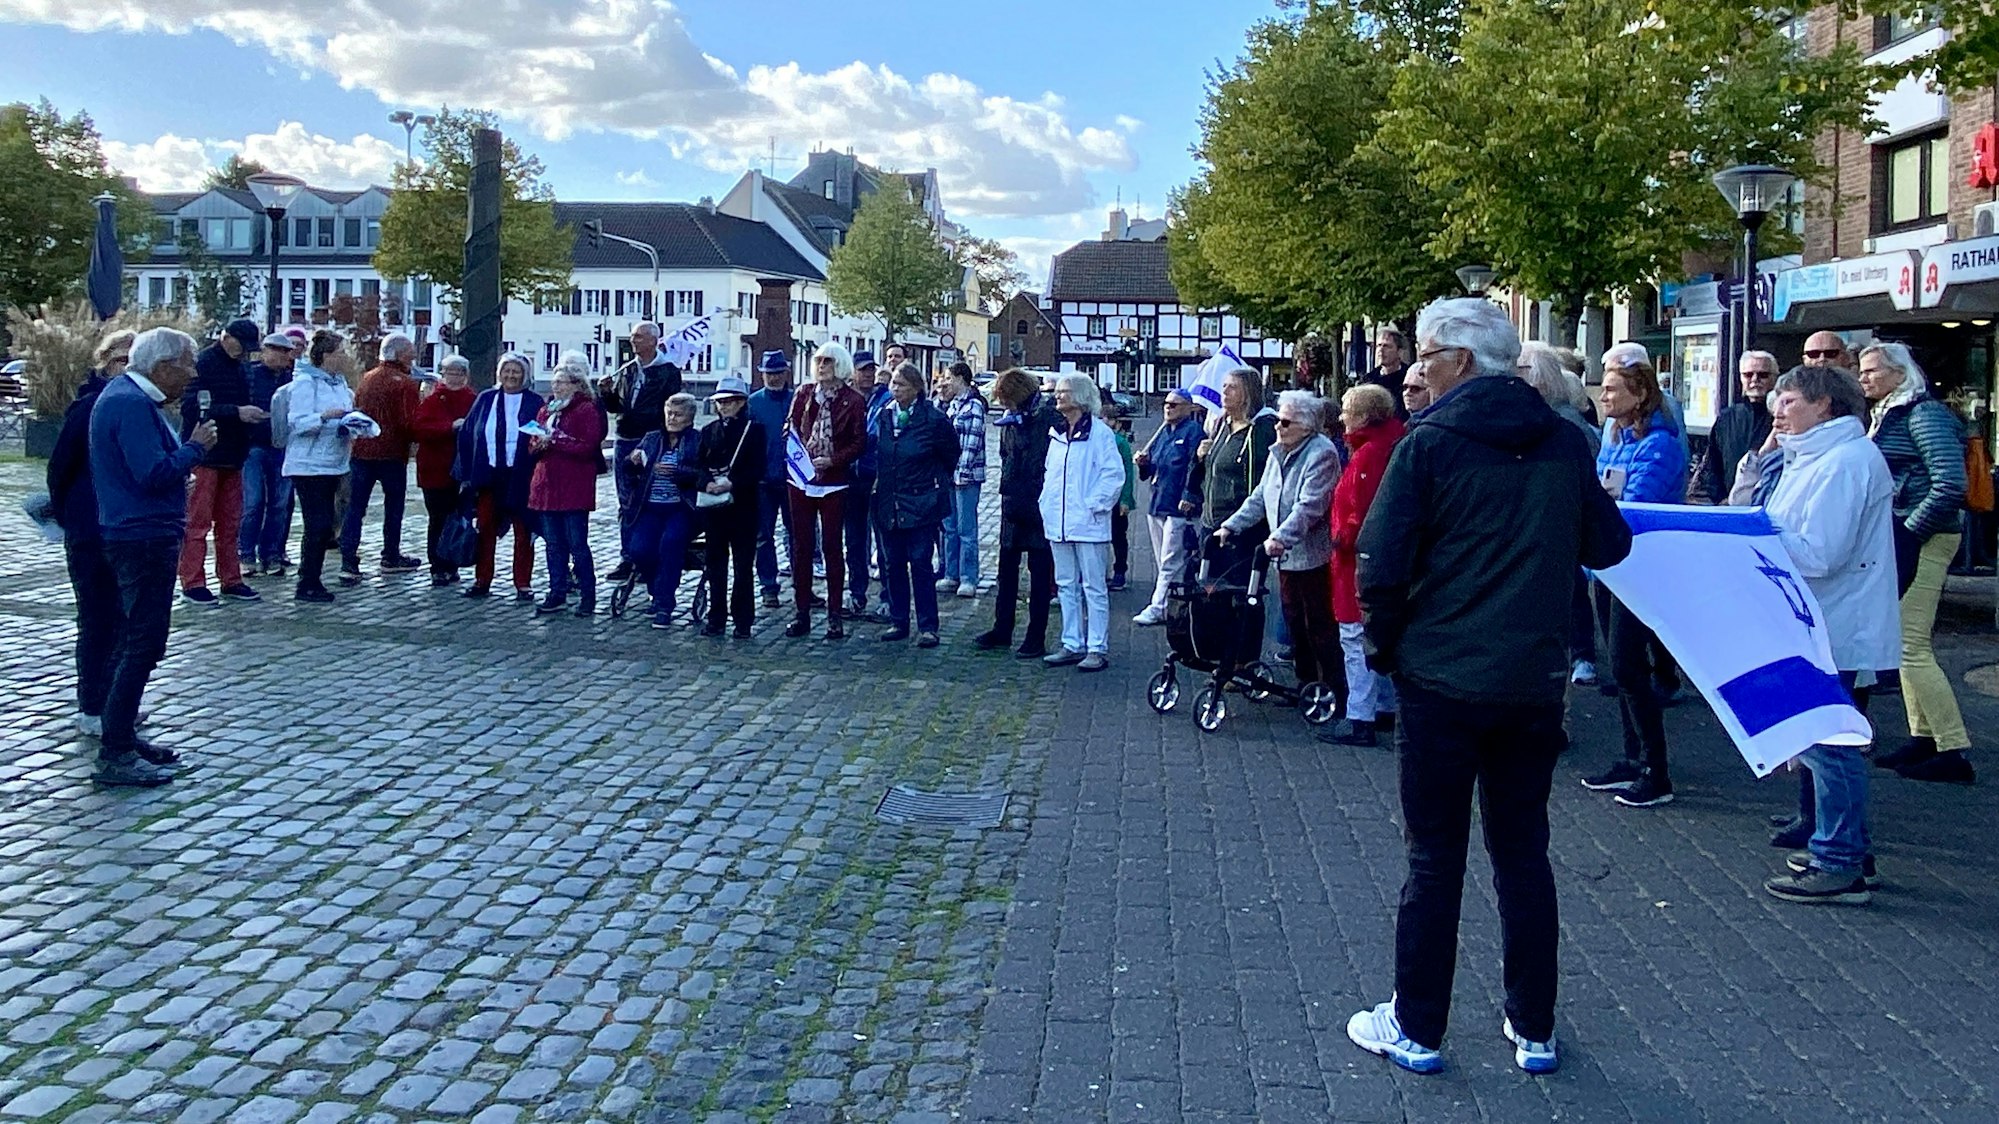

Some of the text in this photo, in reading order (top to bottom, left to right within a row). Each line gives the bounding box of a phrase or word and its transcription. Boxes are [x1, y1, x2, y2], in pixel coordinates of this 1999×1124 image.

[1898, 266, 1910, 295] A
[1925, 246, 1999, 293] A RATHA
